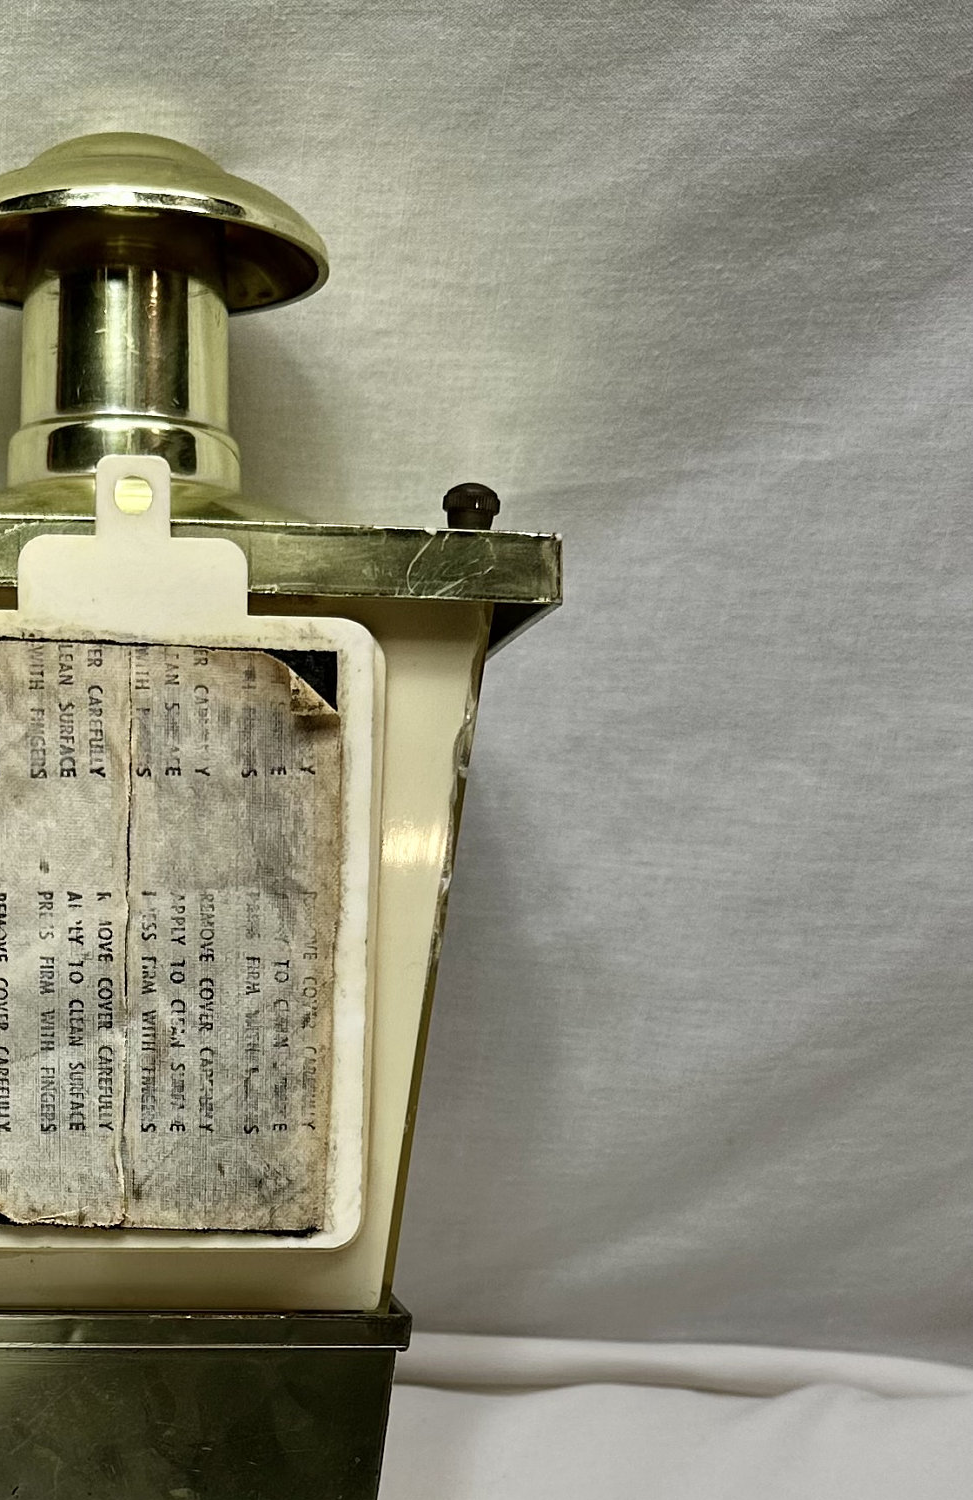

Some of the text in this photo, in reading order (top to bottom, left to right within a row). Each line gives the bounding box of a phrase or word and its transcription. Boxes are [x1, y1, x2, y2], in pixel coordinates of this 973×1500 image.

[30, 707, 48, 779] FINGERS
[58, 702, 77, 778] SURFACE
[87, 684, 106, 779] CAREFULLY
[39, 955, 55, 996] FIRM
[68, 960, 84, 985] TO
[170, 959, 186, 984] TO
[274, 959, 290, 984] TO
[39, 1008, 55, 1051] WITH
[68, 999, 85, 1047] CLEAN
[96, 891, 115, 1132] ROVE COVER CAREFULLY
[199, 977, 215, 1032] COVER
[141, 1010, 157, 1052] WITH
[40, 1066, 57, 1133] FINGERS
[69, 1062, 86, 1132] SURFACE
